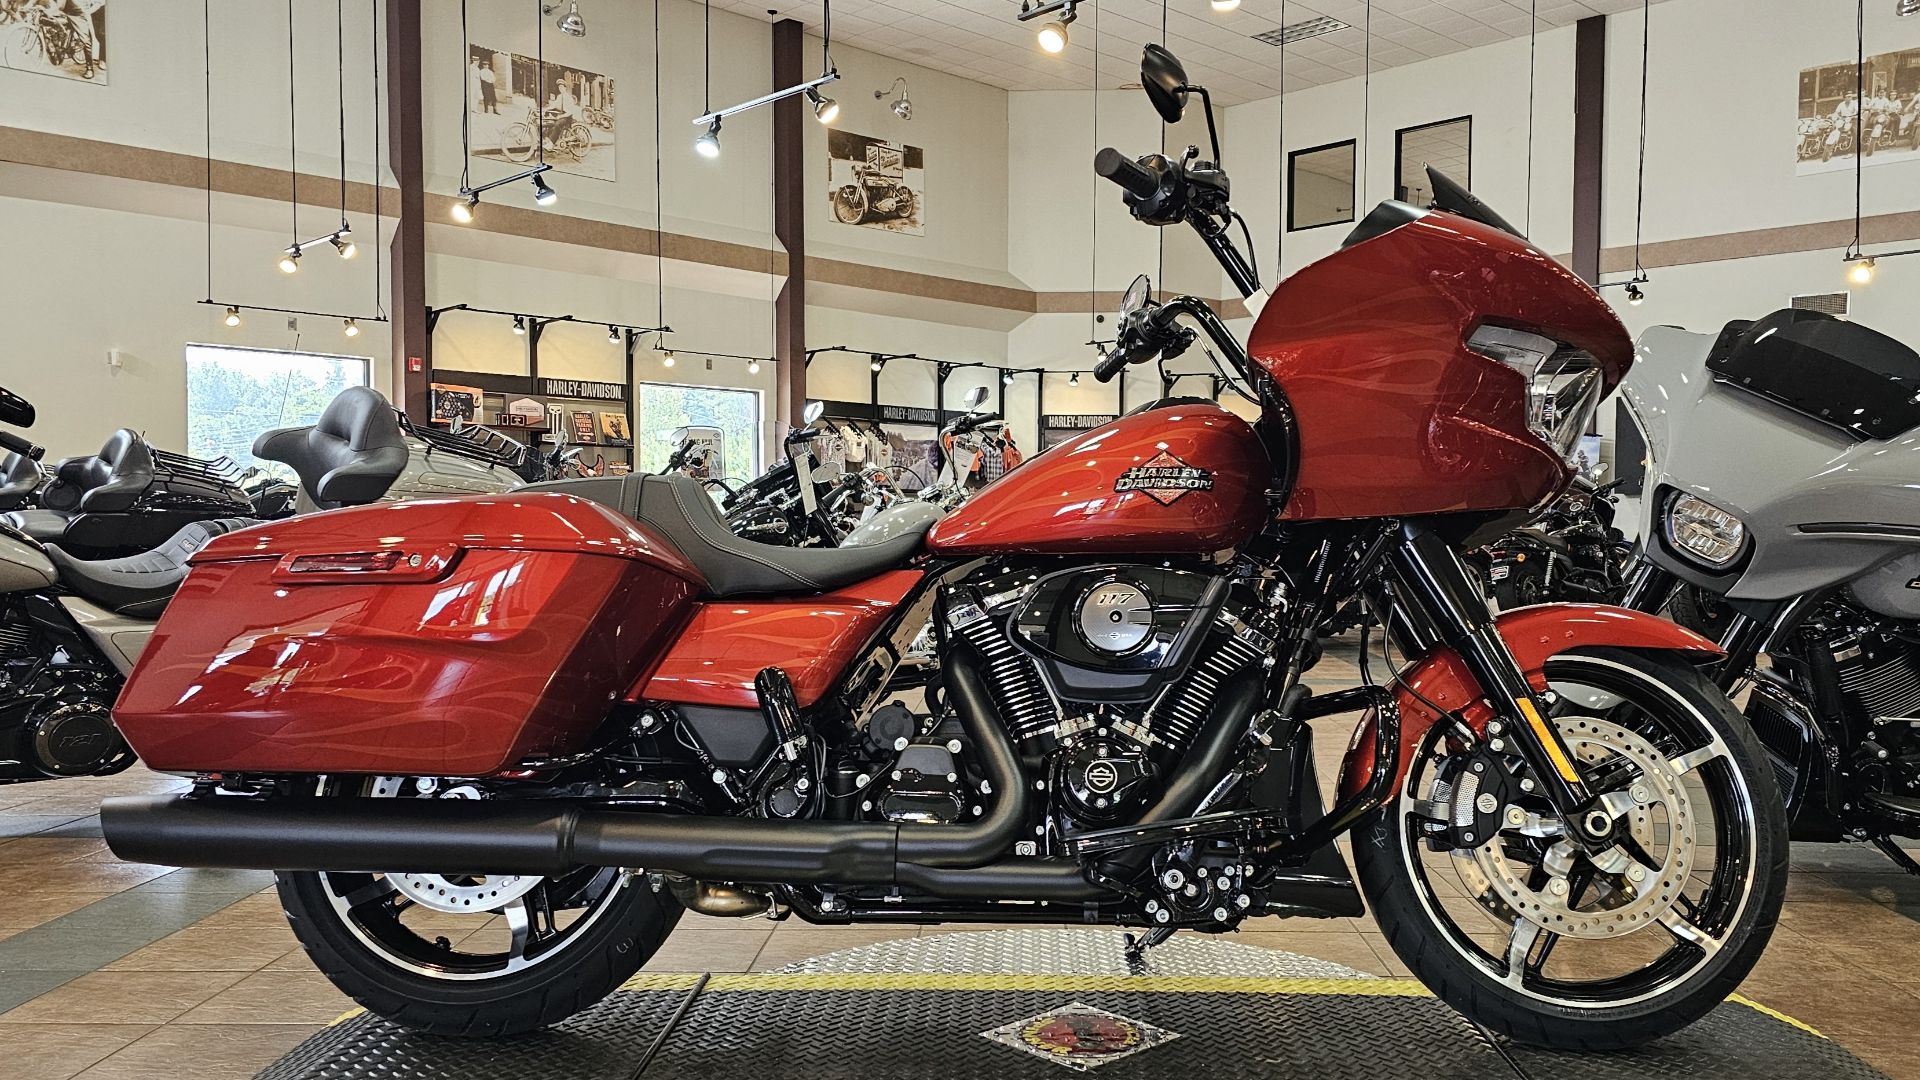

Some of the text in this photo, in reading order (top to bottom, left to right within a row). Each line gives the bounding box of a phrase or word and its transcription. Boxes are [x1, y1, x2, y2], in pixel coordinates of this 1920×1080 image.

[546, 379, 622, 400] HARLEY-DAVIDSON
[883, 406, 936, 422] HARLEY-DAVIDSON
[1115, 477, 1213, 490] DAVIDSON
[1097, 592, 1137, 606] 117
